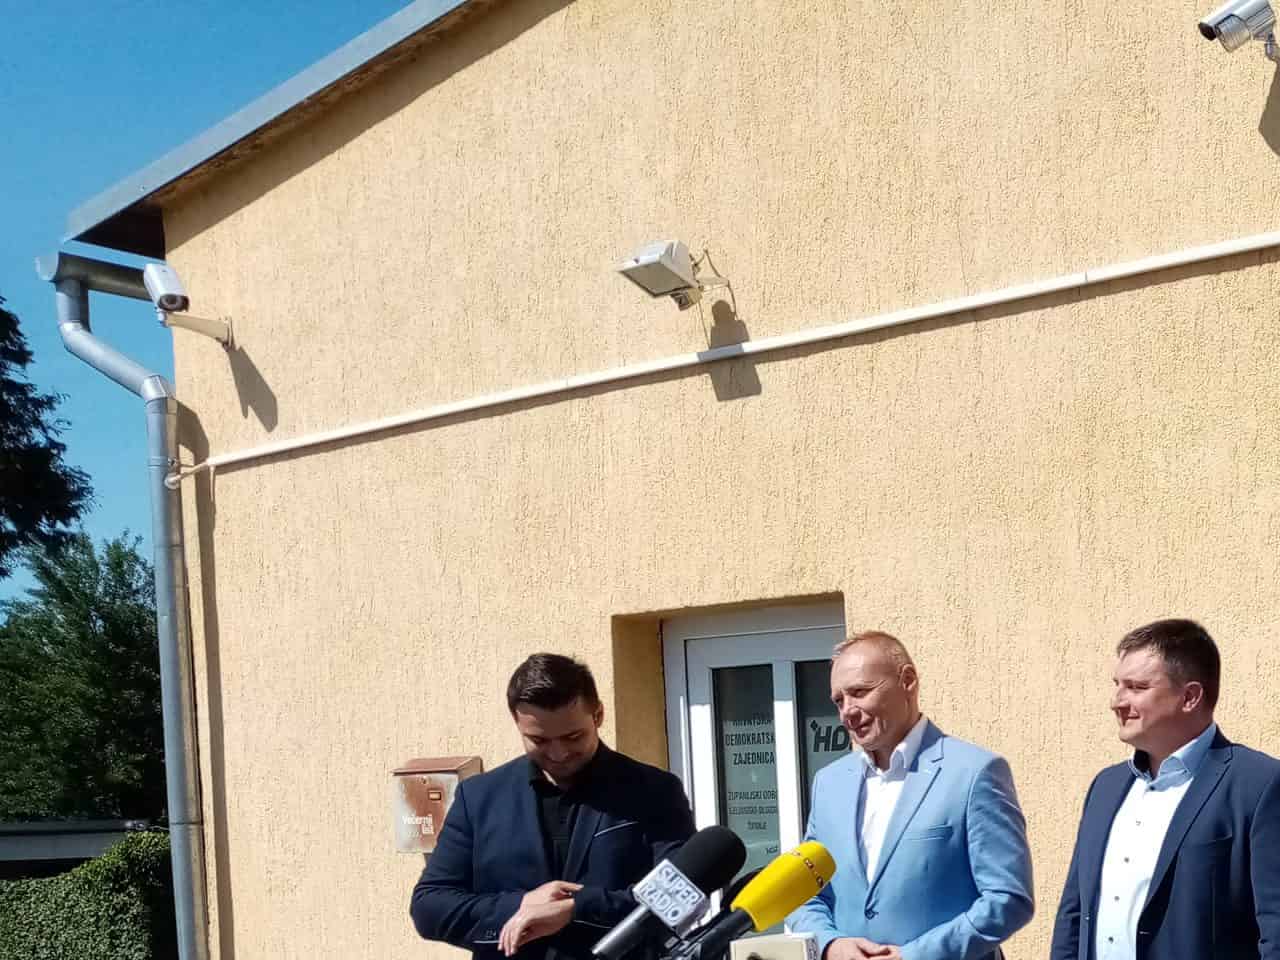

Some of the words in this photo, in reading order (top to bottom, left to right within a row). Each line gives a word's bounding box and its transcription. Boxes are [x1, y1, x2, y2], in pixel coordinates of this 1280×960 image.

[725, 732, 776, 746] DEMOKRATSK
[811, 721, 851, 752] HD
[733, 751, 775, 765] ZAJEDNICA
[640, 880, 681, 922] RADIO
[655, 866, 699, 906] SUPER
